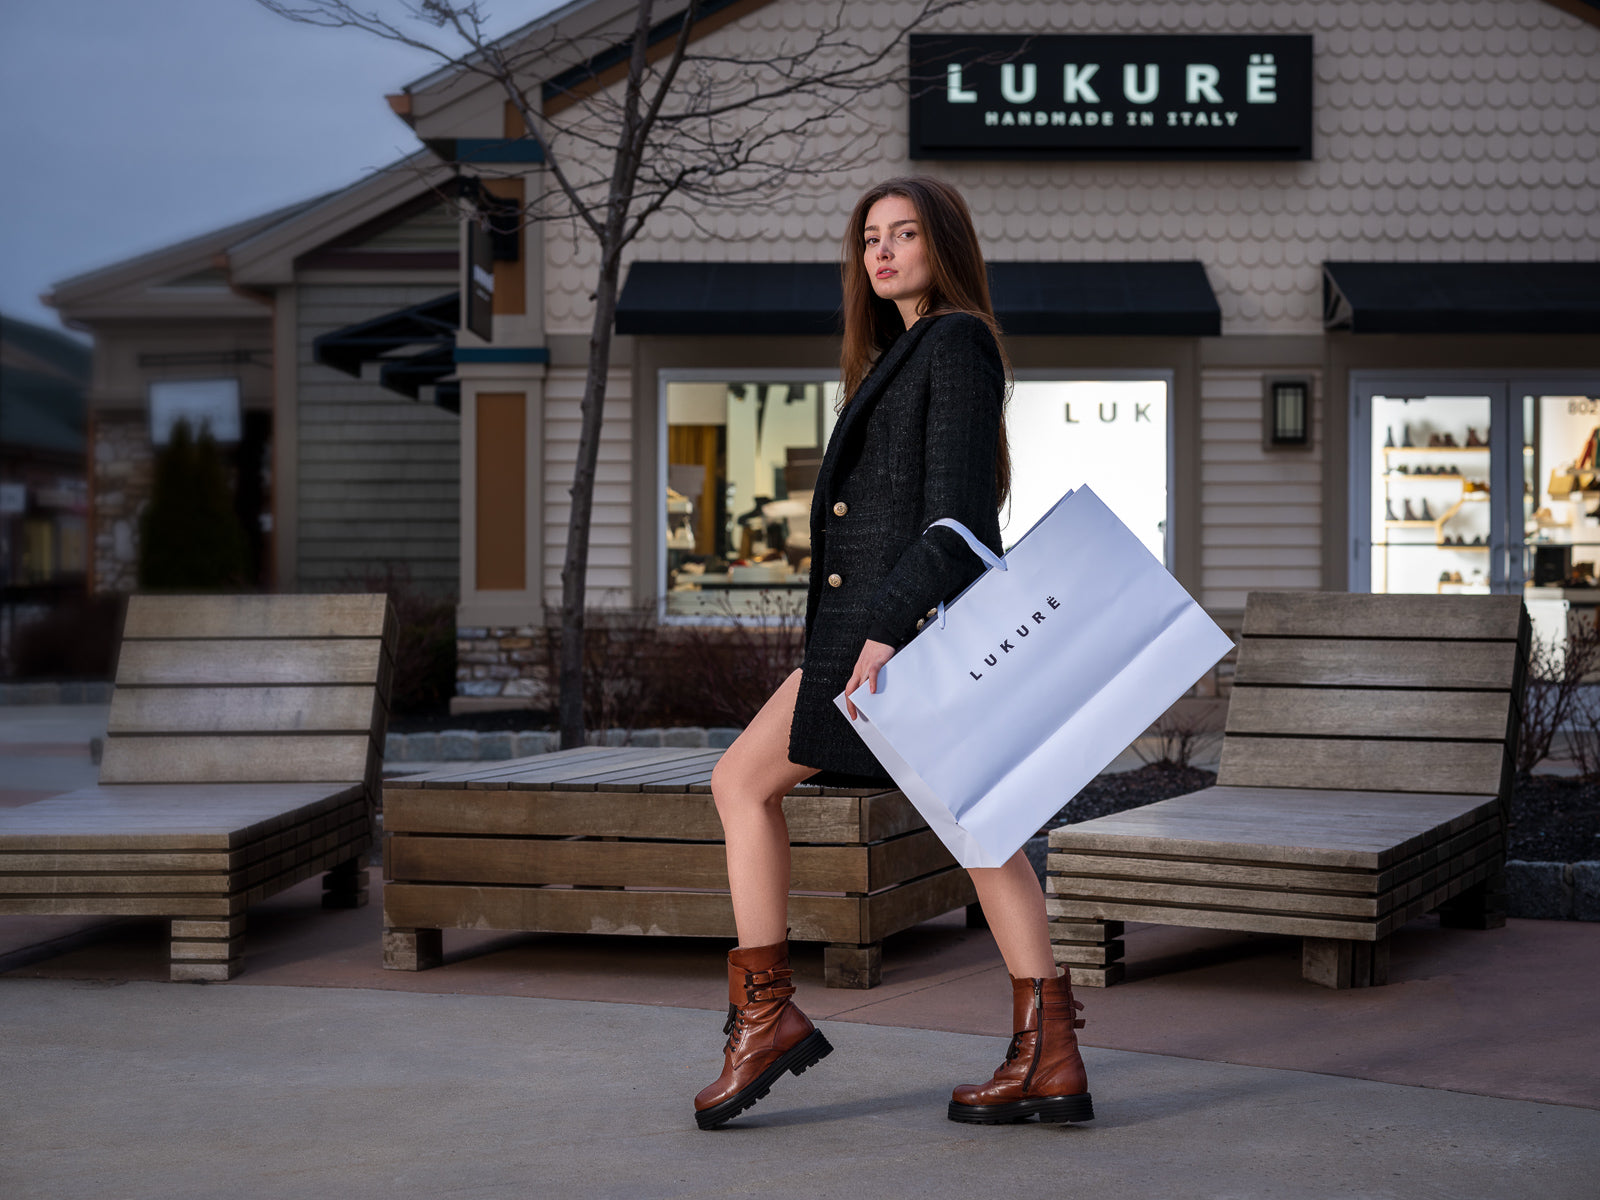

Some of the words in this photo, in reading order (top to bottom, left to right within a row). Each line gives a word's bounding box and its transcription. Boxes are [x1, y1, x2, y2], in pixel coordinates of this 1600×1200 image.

[946, 53, 1278, 104] LUKURË
[984, 111, 1114, 126] HANDMADE
[1126, 111, 1155, 126] IN
[1166, 111, 1239, 126] ITALY
[1065, 402, 1151, 424] LUK
[969, 595, 1061, 681] LUKURË
